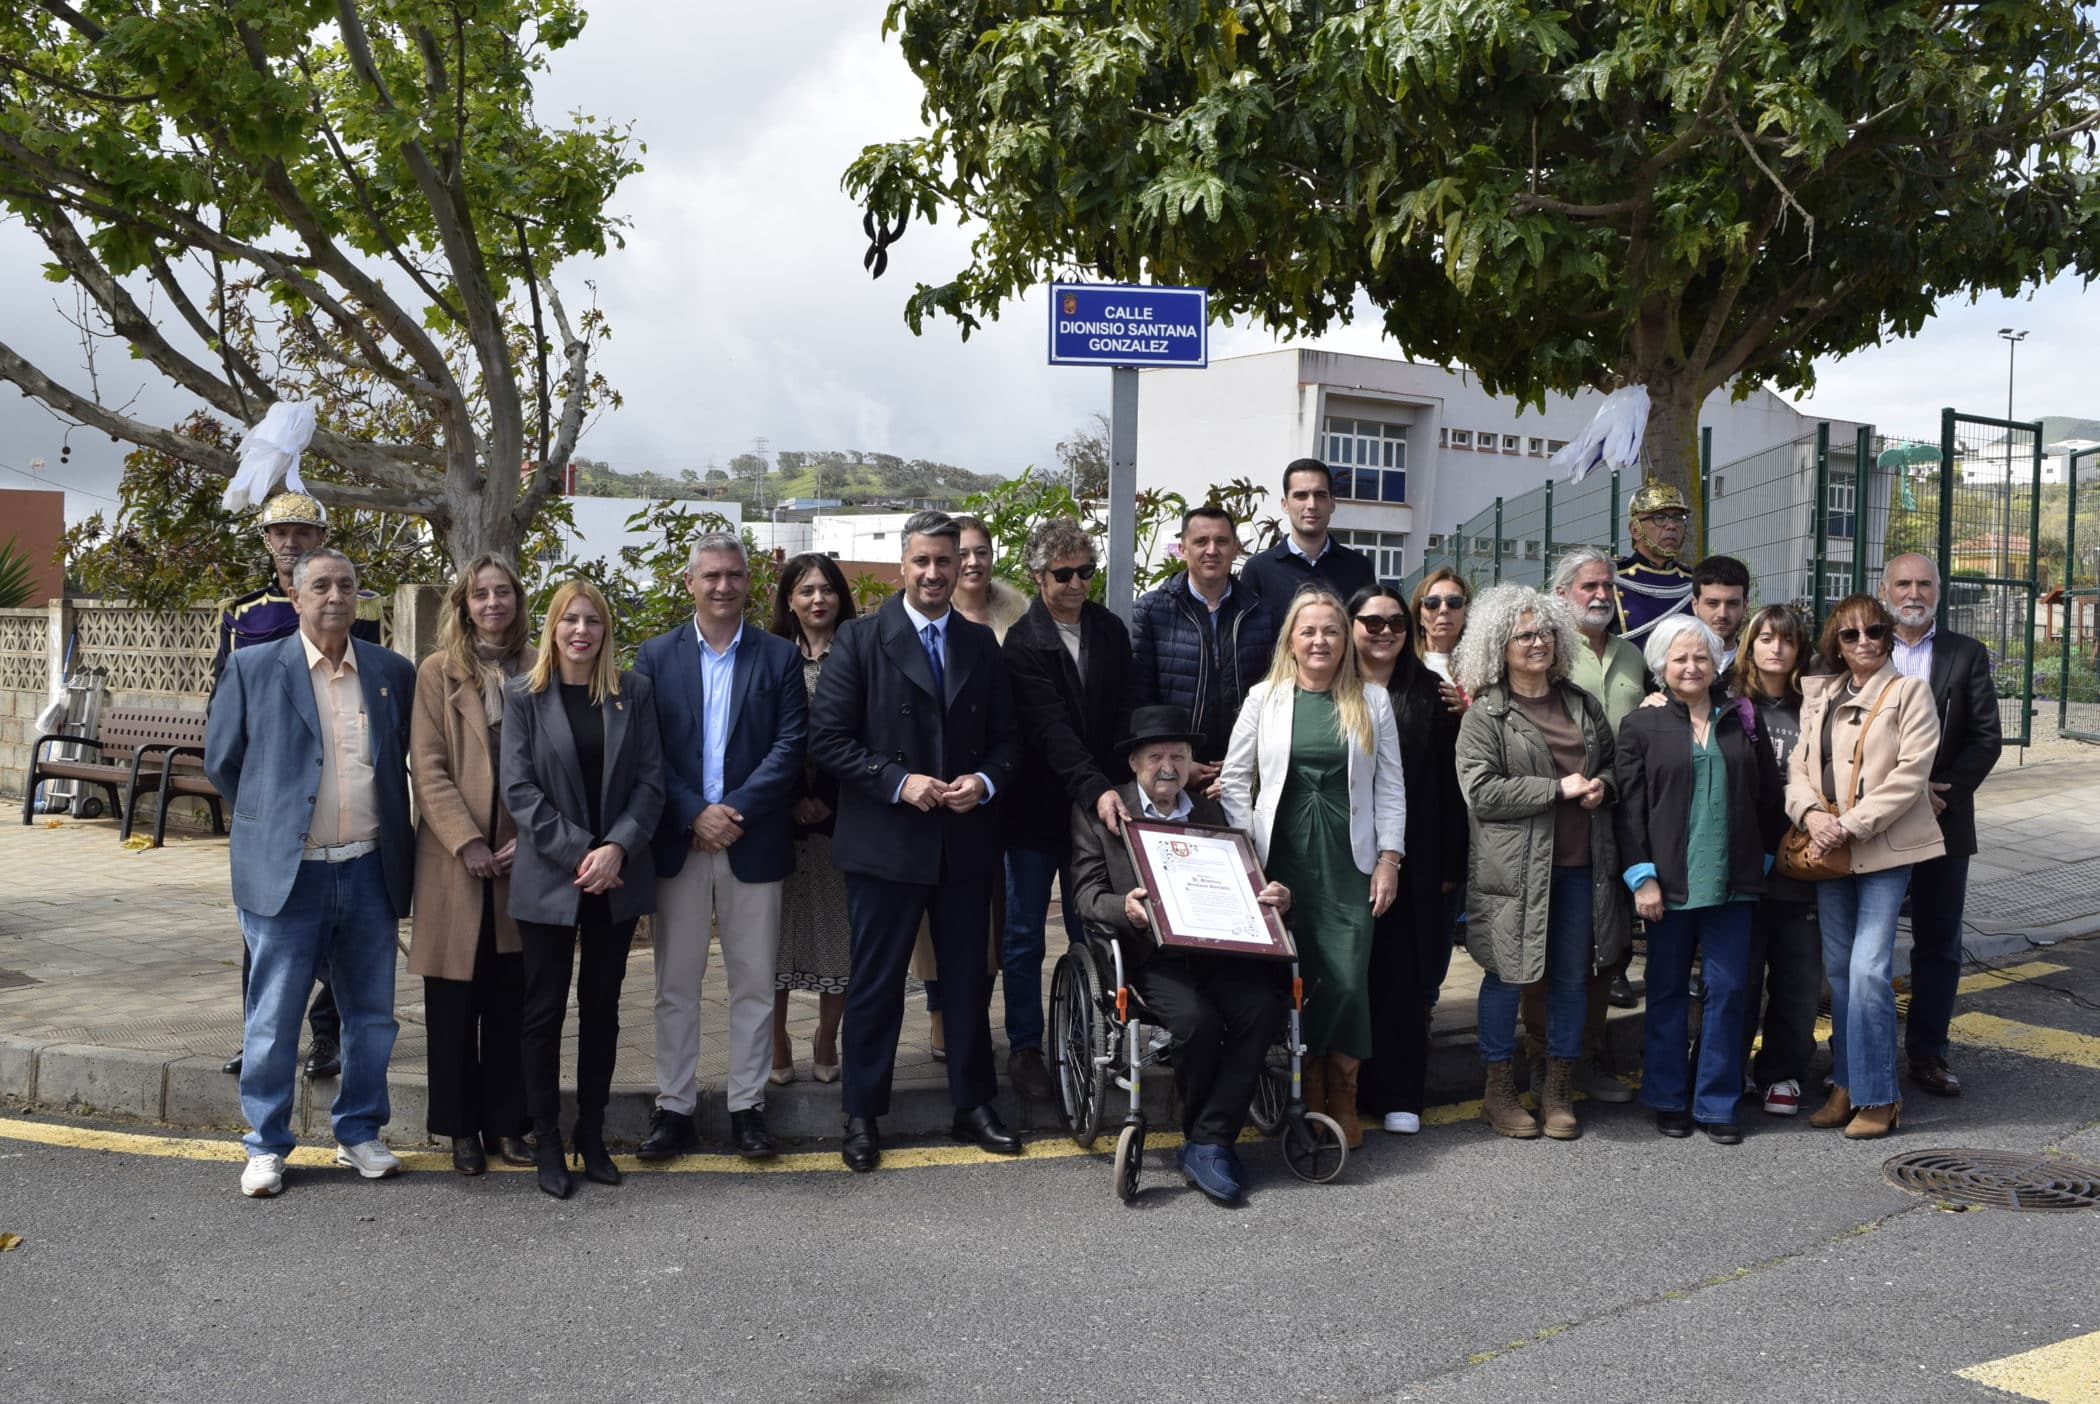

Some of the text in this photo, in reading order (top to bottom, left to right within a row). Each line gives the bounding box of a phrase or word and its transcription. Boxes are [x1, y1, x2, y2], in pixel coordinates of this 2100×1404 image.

[1105, 306, 1153, 320] CALLE
[1060, 321, 1197, 338] DIONISIO SANTANA
[1089, 339, 1169, 353] GONZALEZ
